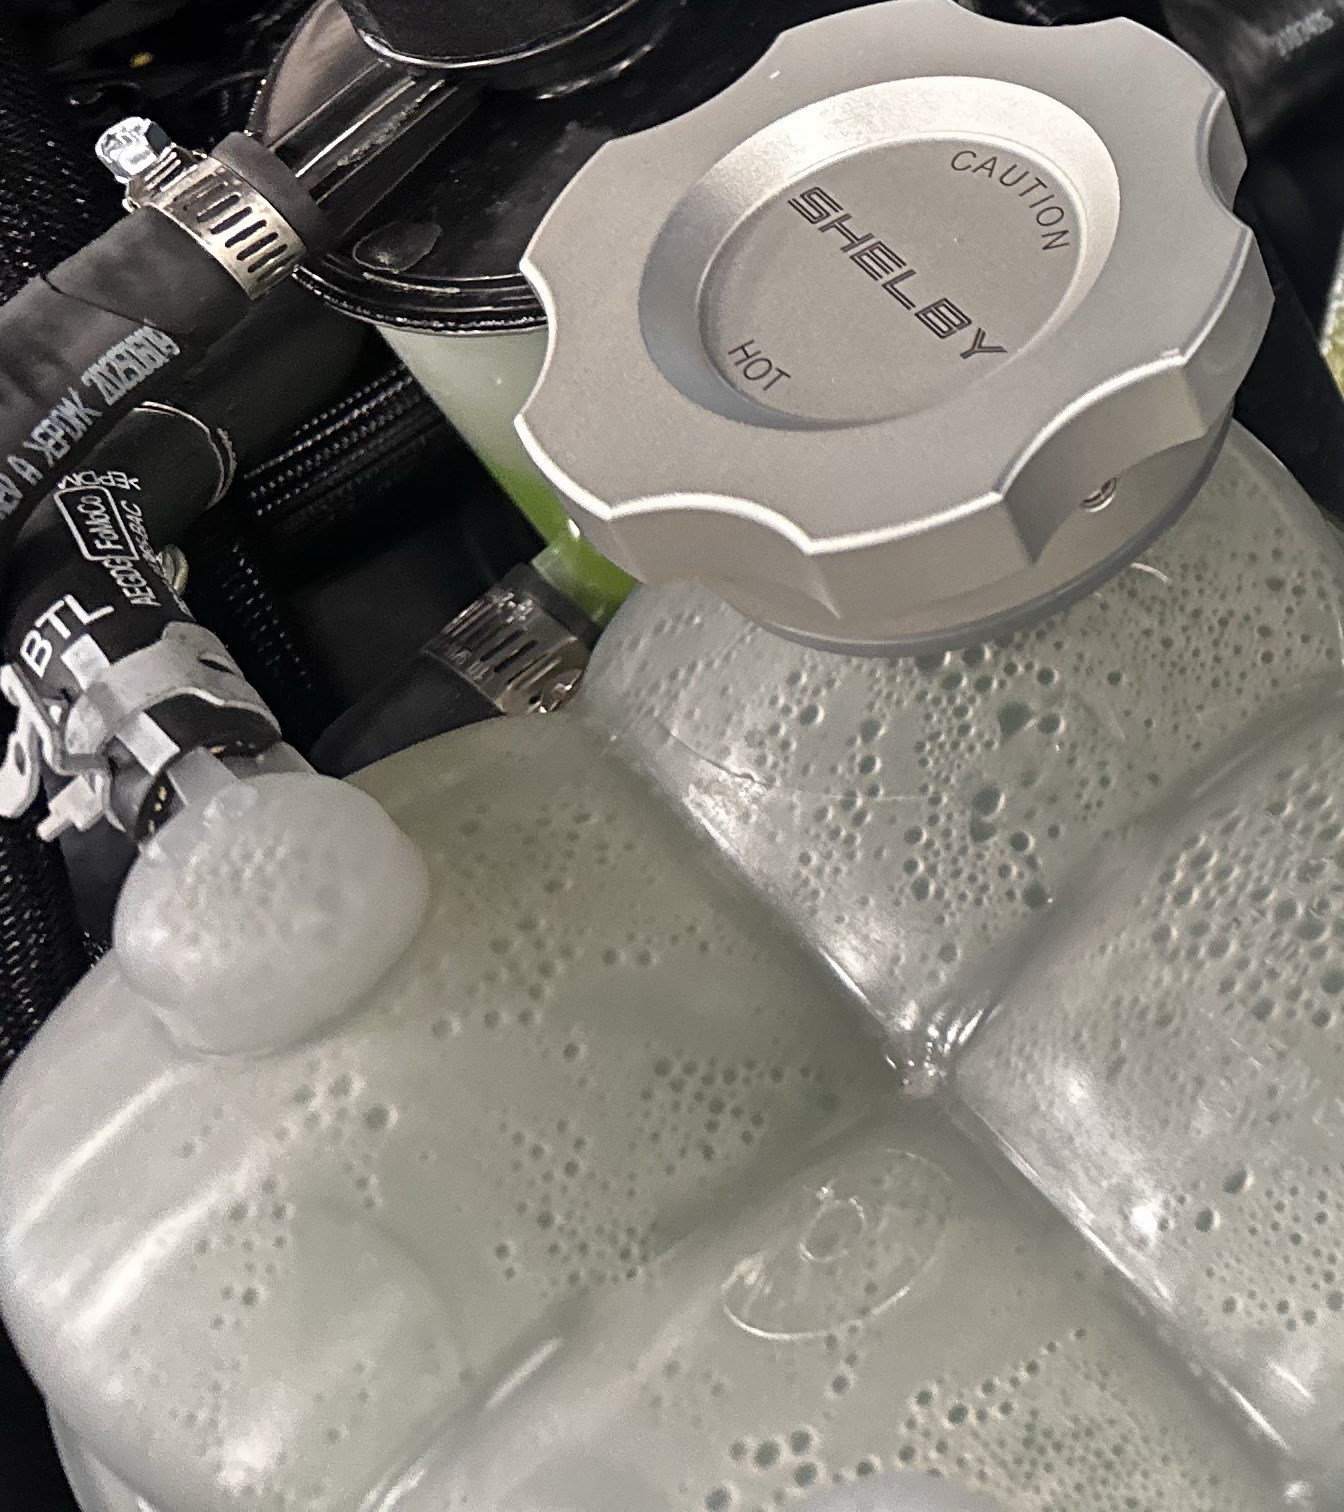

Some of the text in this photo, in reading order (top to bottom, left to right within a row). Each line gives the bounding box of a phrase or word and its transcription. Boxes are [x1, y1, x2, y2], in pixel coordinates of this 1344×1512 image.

[950, 150, 1070, 252] CAUTION
[788, 186, 1008, 361] SHELBY
[727, 338, 792, 392] HOT
[20, 594, 114, 678] BTL
